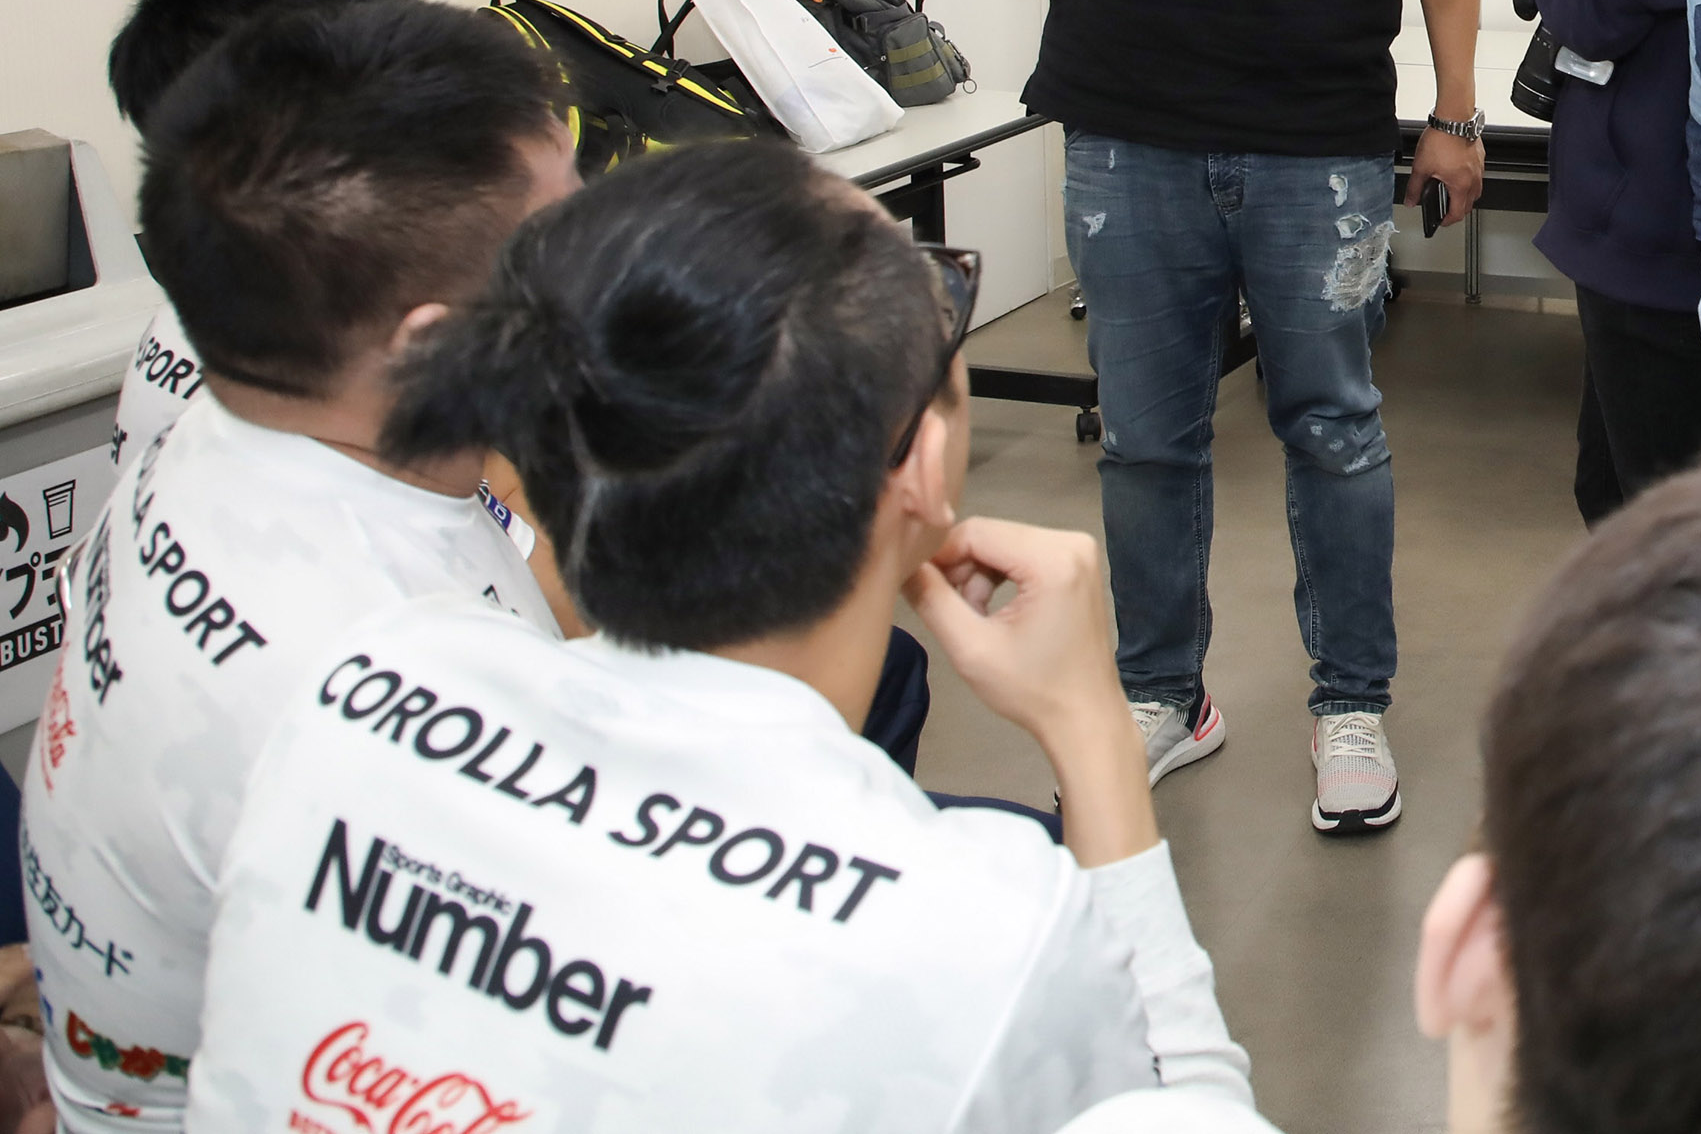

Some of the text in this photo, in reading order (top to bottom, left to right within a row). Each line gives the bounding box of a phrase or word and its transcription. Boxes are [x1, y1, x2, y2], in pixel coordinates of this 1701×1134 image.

[140, 521, 268, 667] SPORT
[318, 654, 902, 924] COROLLA SPORT
[303, 817, 653, 1052] Number
[302, 1021, 537, 1134] Coca-C
